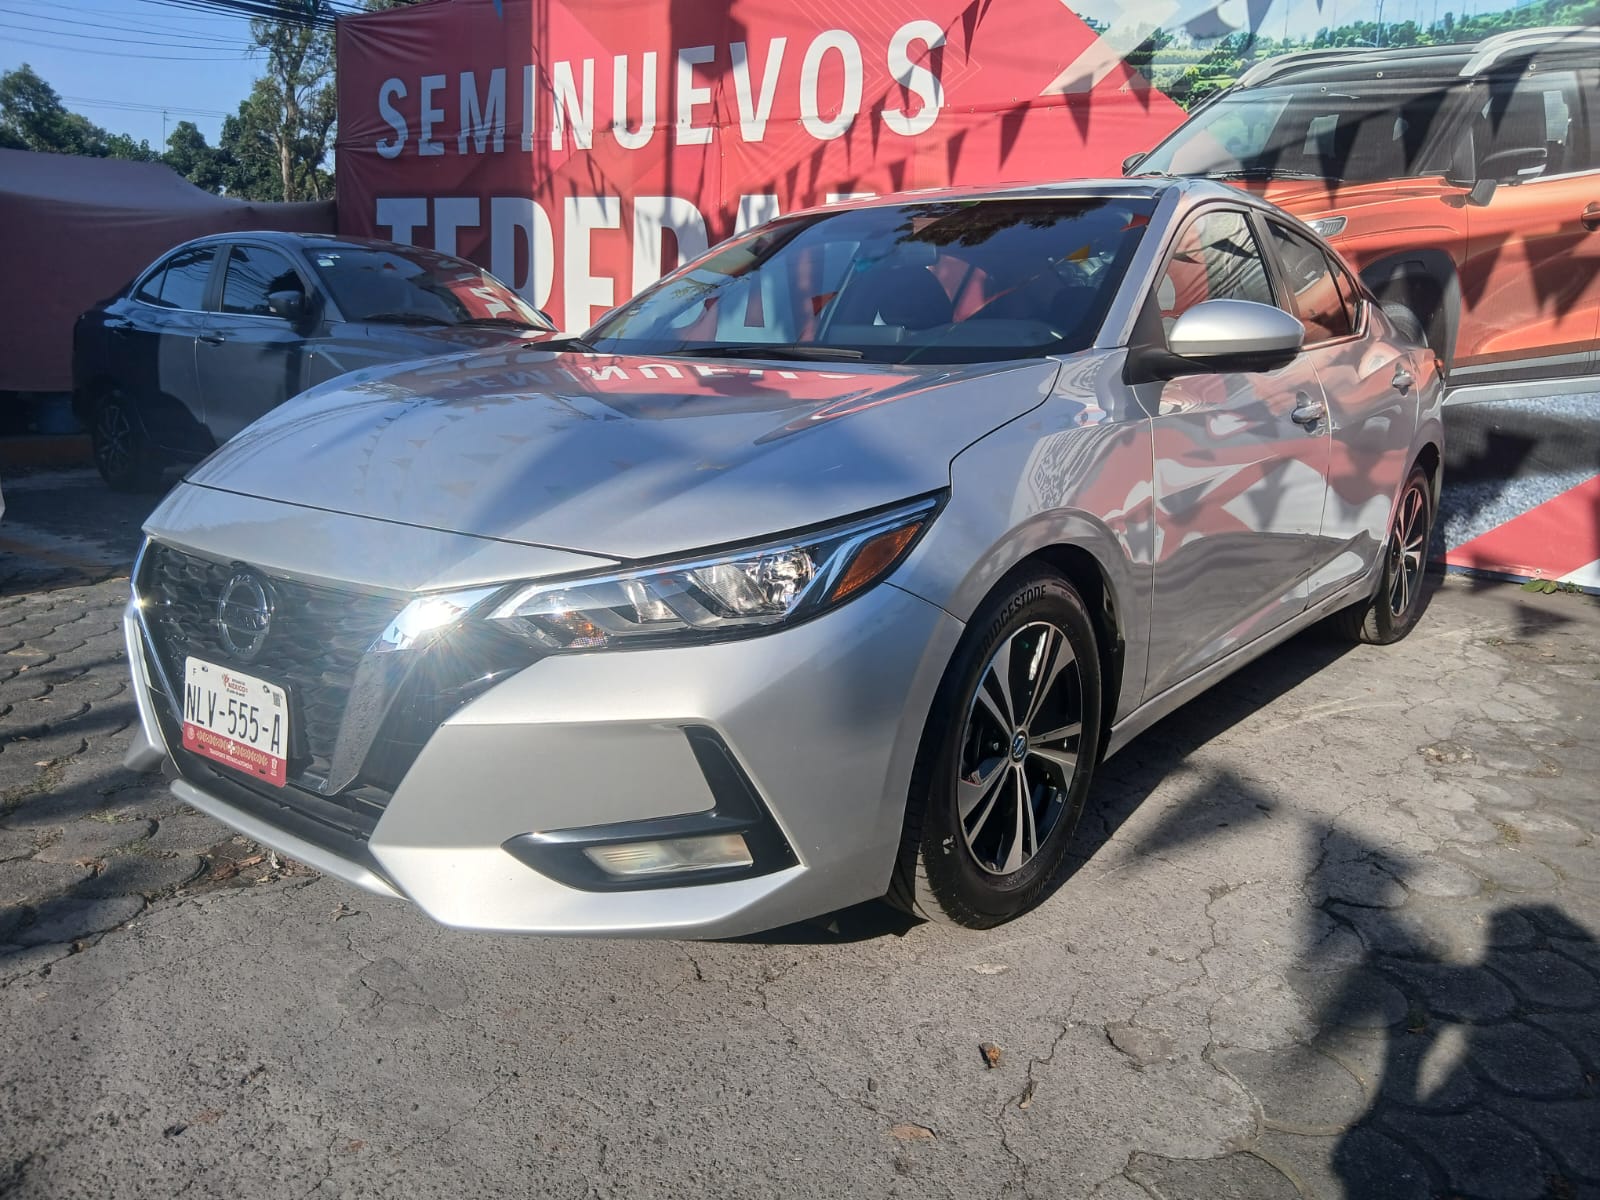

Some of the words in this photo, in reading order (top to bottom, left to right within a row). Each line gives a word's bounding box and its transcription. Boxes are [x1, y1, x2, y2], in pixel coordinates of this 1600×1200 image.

[376, 19, 948, 160] SEMINUEVOS
[976, 583, 1048, 660] RIDGESTONE
[186, 682, 281, 755] NLV-555-A
